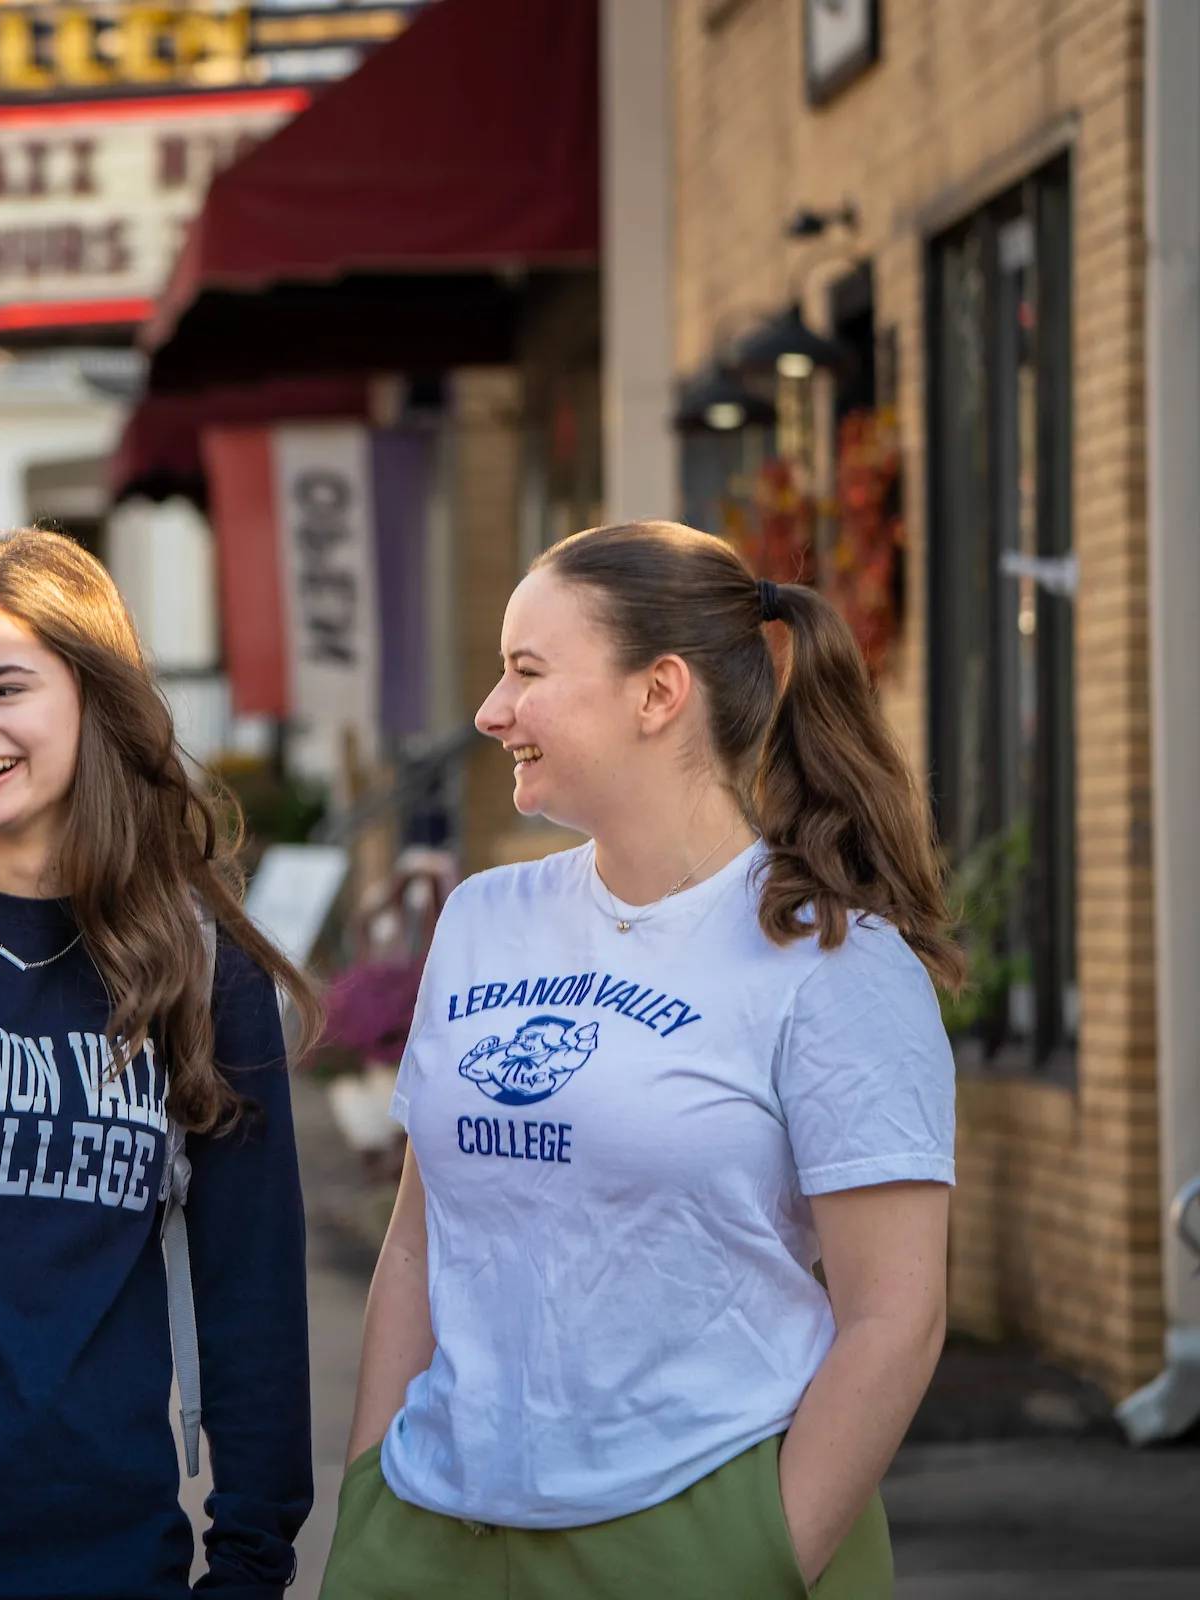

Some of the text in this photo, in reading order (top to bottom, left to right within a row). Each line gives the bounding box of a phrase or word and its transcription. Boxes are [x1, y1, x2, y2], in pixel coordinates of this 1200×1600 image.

[295, 470, 355, 666] OPEN
[448, 972, 701, 1037] LEBANON VALLEY
[457, 1116, 572, 1163] COLLEGE
